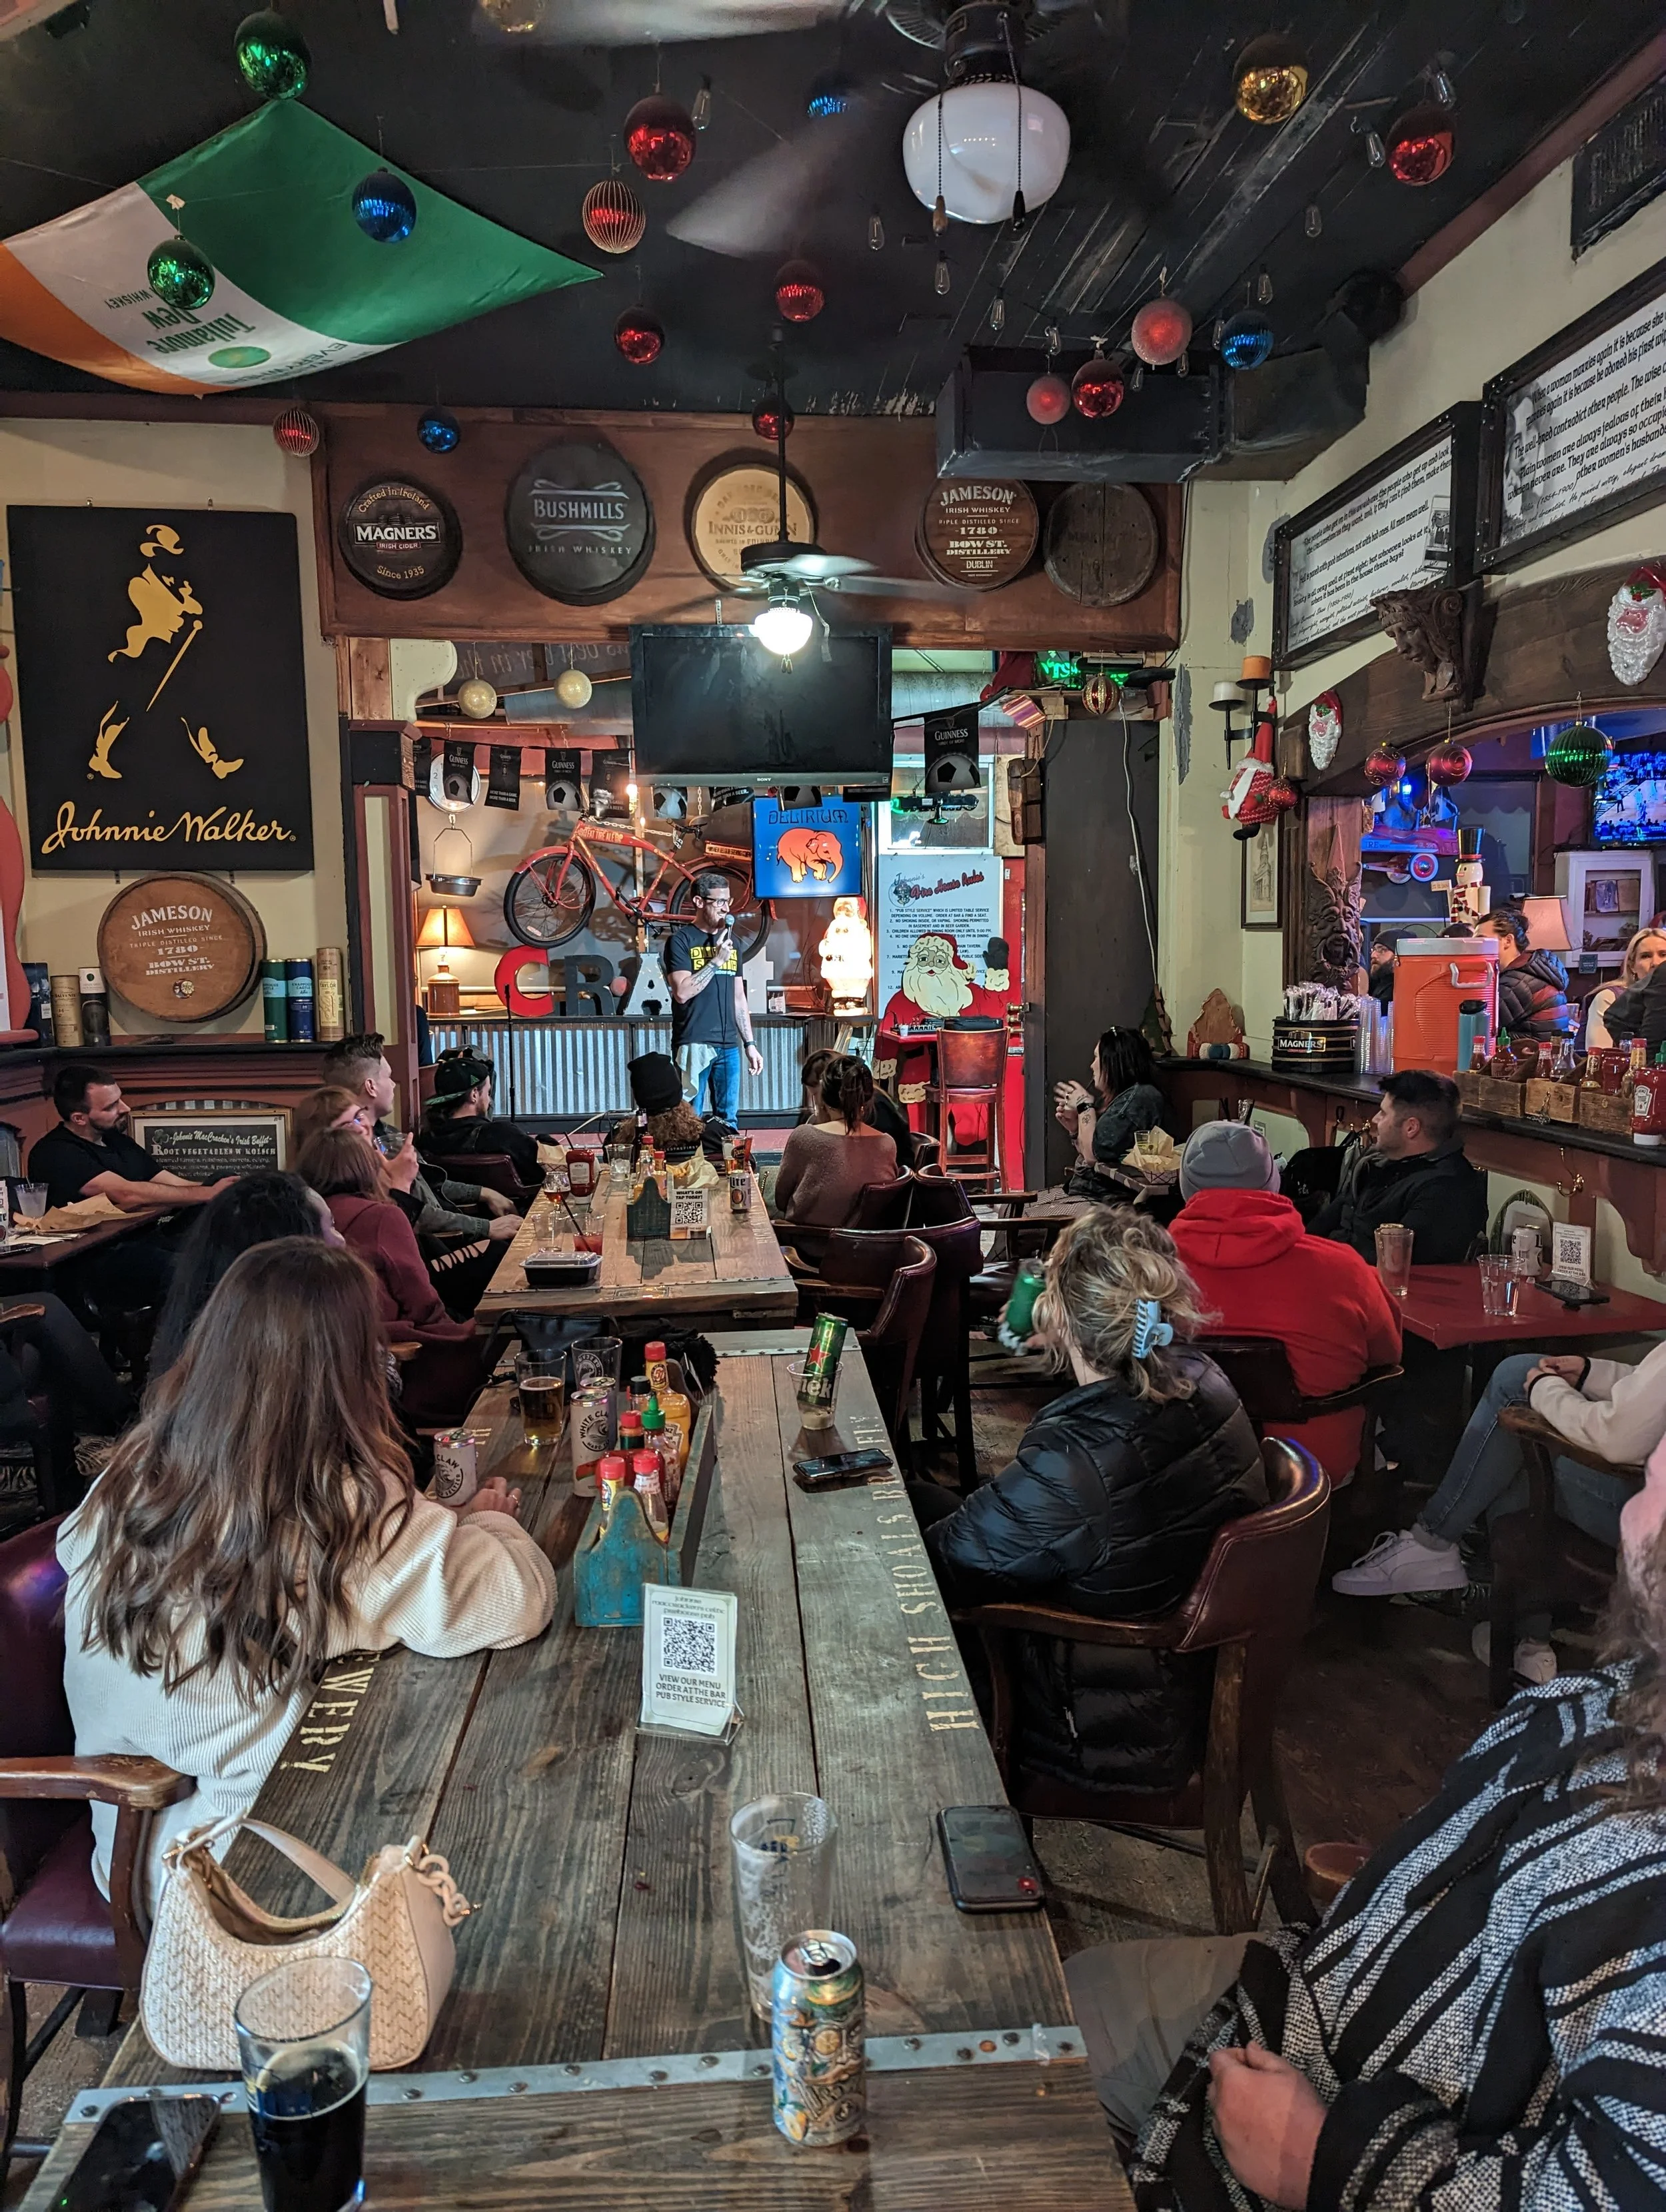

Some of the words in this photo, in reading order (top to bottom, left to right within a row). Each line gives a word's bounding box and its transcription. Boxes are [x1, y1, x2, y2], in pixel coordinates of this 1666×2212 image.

[105, 290, 153, 308] WHISKEY
[141, 307, 201, 329] Dew
[146, 312, 256, 354] Tullamore
[1551, 376, 1571, 394] woman
[1573, 356, 1595, 380] marries
[1596, 343, 1613, 365] again
[1613, 337, 1619, 353] it
[1619, 335, 1625, 349] is
[1625, 319, 1651, 345] because
[1652, 311, 1663, 328] she
[1546, 394, 1562, 415] again
[1563, 390, 1568, 402] it
[1569, 388, 1573, 400] is
[1574, 374, 1596, 396] because
[1597, 368, 1604, 383] he
[1605, 352, 1627, 378] adored
[1628, 348, 1637, 363] his
[1638, 335, 1655, 362] first
[1553, 406, 1587, 436] contradict
[1587, 399, 1605, 418] other
[1607, 384, 1629, 410] people.
[1631, 374, 1643, 392] The
[1645, 363, 1661, 386] wise
[1537, 450, 1561, 470] women
[1562, 442, 1575, 458] are
[1577, 426, 1601, 450] always
[1602, 410, 1629, 436] jealous
[1630, 404, 1640, 420] of
[1641, 394, 1662, 413] their
[1531, 472, 1551, 489] never
[1552, 463, 1566, 477] are.
[1568, 454, 1585, 470] They
[1586, 444, 1599, 458] are
[1599, 428, 1627, 451] always
[1628, 424, 1637, 436] so
[1577, 463, 1597, 481] other
[1598, 442, 1630, 469] women's
[359, 488, 387, 512] Crafted
[387, 487, 397, 496] in
[400, 488, 430, 511] Ireland
[940, 486, 1014, 506] JAMESON
[534, 499, 624, 520] BUSHMILLS
[357, 525, 437, 541] MAGNERS
[1401, 533, 1416, 549] looks
[377, 566, 401, 578] Since
[405, 566, 424, 578] 1935
[966, 560, 993, 569] DUBLIN
[934, 729, 968, 741] GUINNESS
[449, 755, 468, 765] GUINNESS
[552, 760, 574, 769] GUINNESS
[768, 810, 848, 824] DELIRIUM
[41, 801, 174, 855] Johnnie
[175, 806, 292, 842] Walker
[910, 884, 933, 899] Fire
[934, 879, 961, 894] House
[962, 869, 985, 887] Rules
[131, 905, 213, 930] JAMESON
[167, 925, 210, 933] WHISKEY
[146, 964, 215, 975] DISTILLERY
[149, 959, 185, 968] BOW
[1279, 1039, 1323, 1048] MAGNERS
[194, 1130, 234, 1145] MacCracken's
[236, 1135, 249, 1145] Irish
[151, 1144, 179, 1155] ROOT
[580, 1414, 594, 1438] WHITE
[436, 1454, 459, 1468] CLAW
[446, 1474, 460, 1496] SELTZER
[876, 1512, 941, 1616] SHOALS
[656, 1682, 682, 1692] ORDER
[692, 1688, 708, 1696] THE
[710, 1690, 726, 1699] BAR
[659, 1674, 680, 1684] VIEW
[680, 1677, 697, 1686] OUR
[699, 1680, 721, 1690] MENU
[907, 1635, 982, 1732] HIGH
[672, 1693, 694, 1704] STYLE
[695, 1696, 726, 1708] SERVICE
